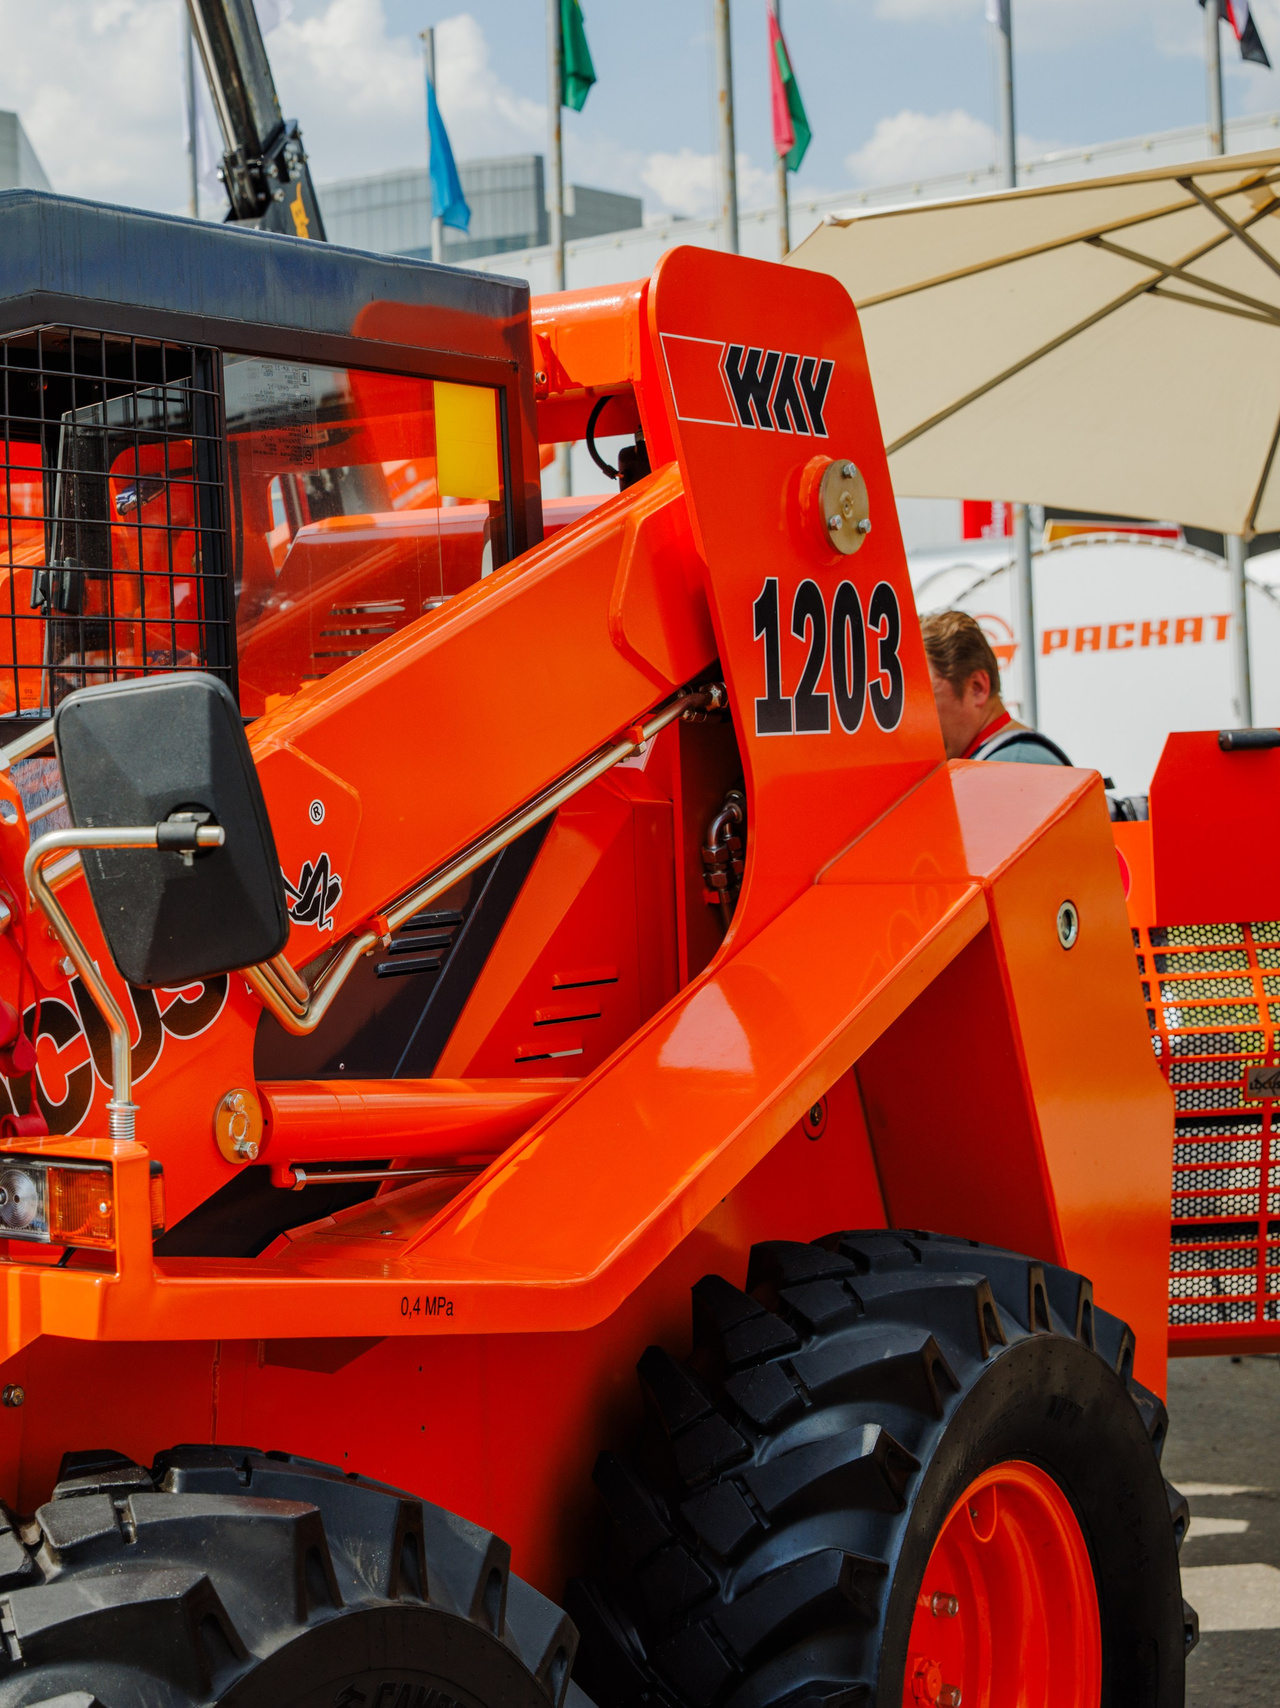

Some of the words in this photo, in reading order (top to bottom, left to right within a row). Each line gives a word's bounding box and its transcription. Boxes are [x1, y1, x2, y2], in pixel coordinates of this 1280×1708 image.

[752, 576, 905, 736] 1203
[401, 1296, 421, 1319] 0,4
[424, 1296, 454, 1316] MPa
